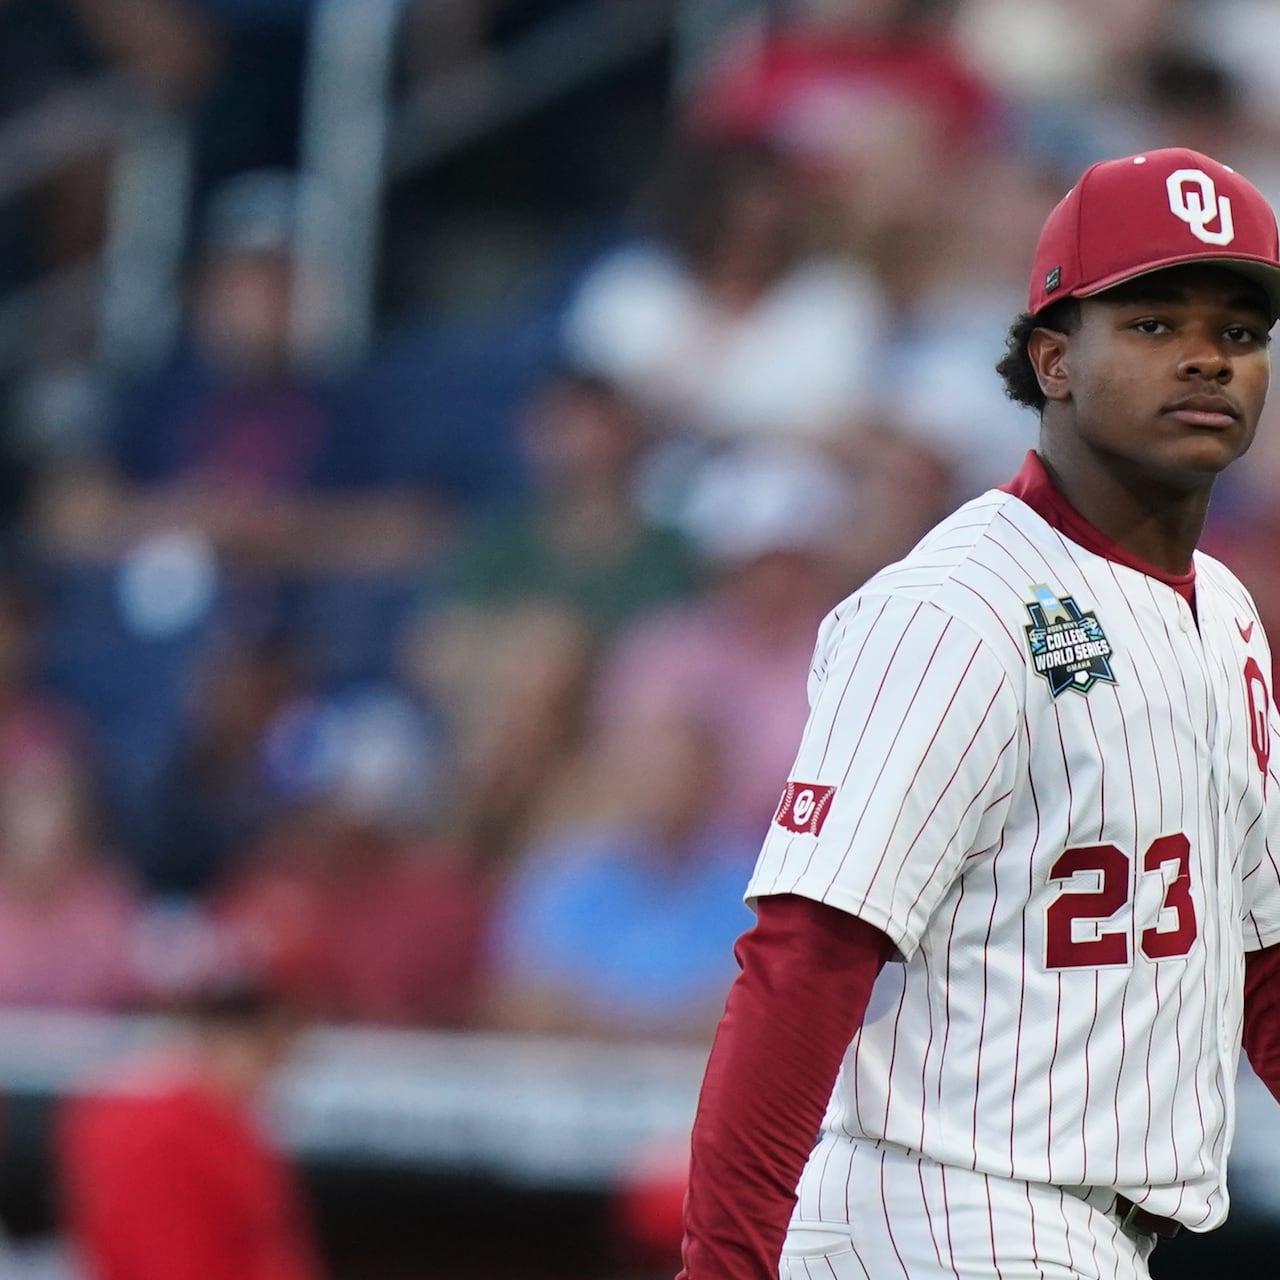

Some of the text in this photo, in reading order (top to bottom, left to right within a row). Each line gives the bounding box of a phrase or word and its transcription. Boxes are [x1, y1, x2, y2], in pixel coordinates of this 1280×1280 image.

[1166, 168, 1235, 246] OU
[1035, 639, 1110, 671] WORLD SERIES
[1046, 628, 1089, 651] COLLEGE
[1066, 660, 1092, 673] OMAHA
[793, 789, 816, 825] OU
[1045, 831, 1198, 971] 23
